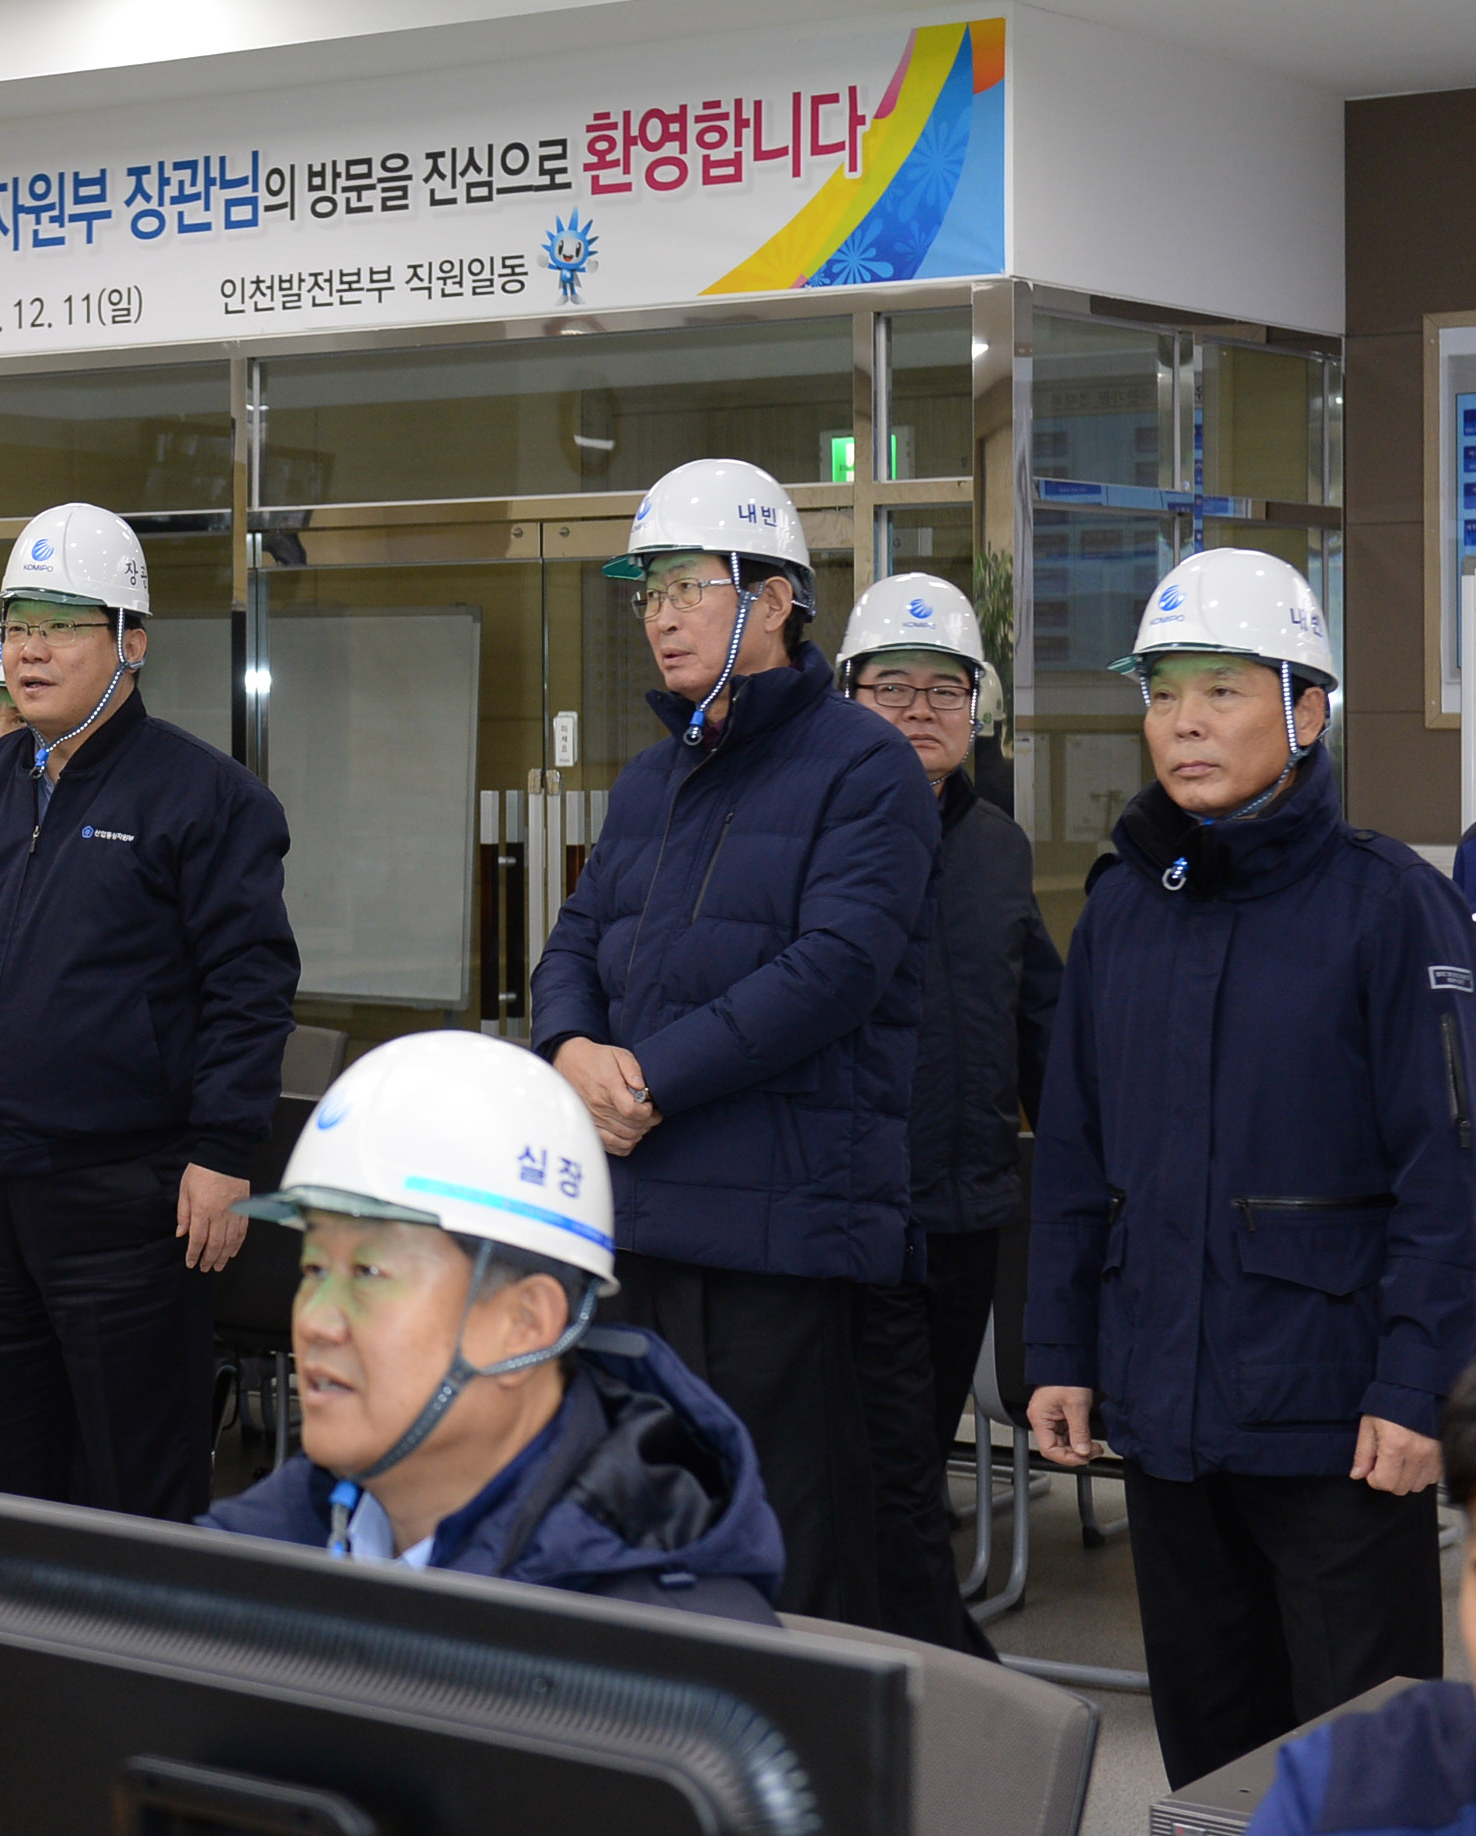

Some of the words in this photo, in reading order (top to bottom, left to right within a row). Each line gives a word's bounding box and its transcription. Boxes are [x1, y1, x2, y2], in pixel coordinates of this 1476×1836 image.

[123, 150, 297, 241] 장관님의
[307, 152, 414, 219] 방문을
[422, 138, 572, 207] 진심으로
[582, 84, 866, 195] 환영합니다
[13, 296, 53, 329] 12.
[64, 285, 144, 326] 11(일)
[220, 265, 396, 315] 인천발전본부
[404, 254, 529, 300] 직원일동
[738, 503, 778, 527] 내빈
[23, 564, 54, 573] KOMIPO
[518, 1146, 583, 1198] 실장
